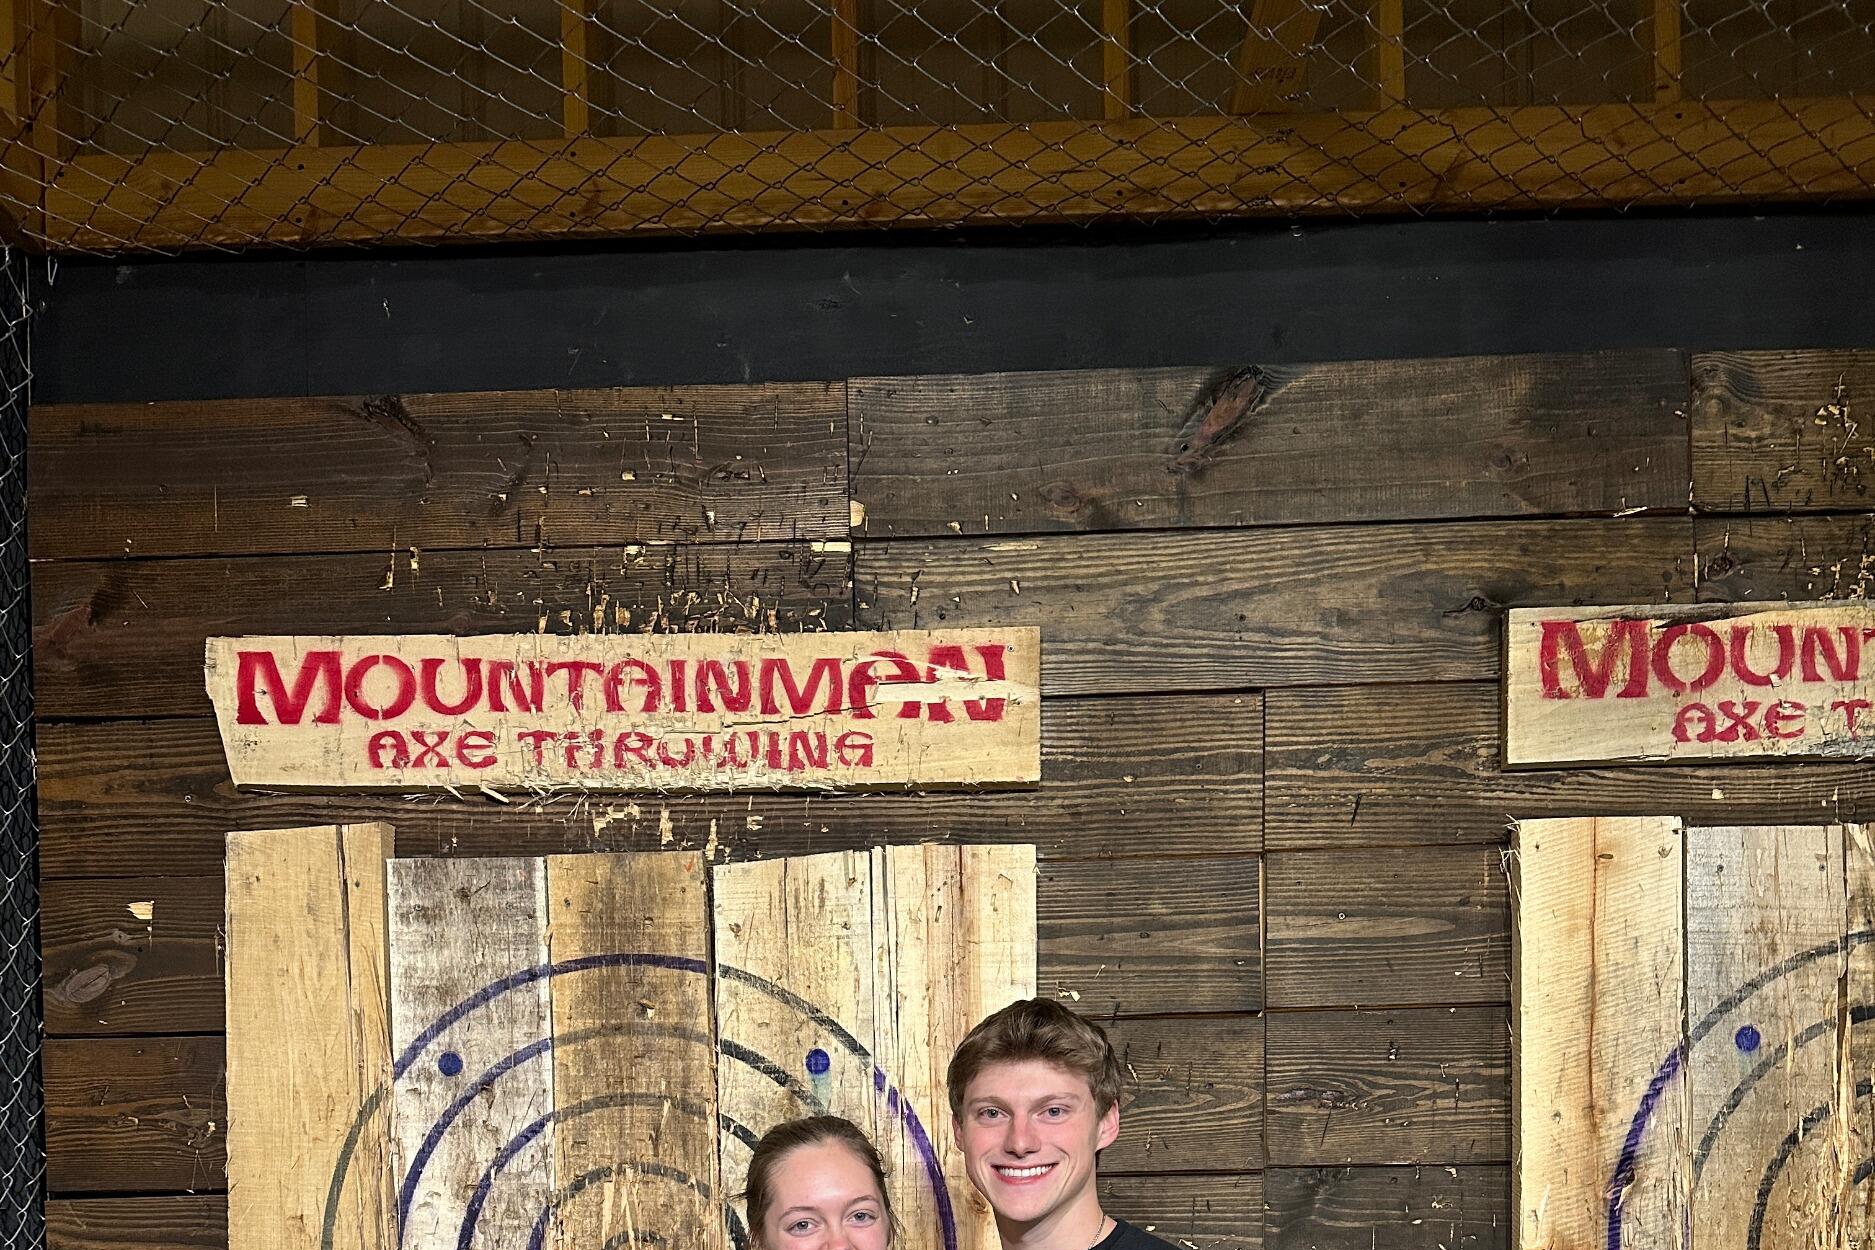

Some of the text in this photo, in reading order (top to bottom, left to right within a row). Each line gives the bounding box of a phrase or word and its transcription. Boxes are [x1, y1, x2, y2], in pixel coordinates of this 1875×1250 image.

[236, 644, 1007, 724] MOUNTAINMAN
[1539, 618, 1875, 699] MOUN
[367, 728, 874, 773] AXE THROWING
[1672, 700, 1807, 743] AXE
